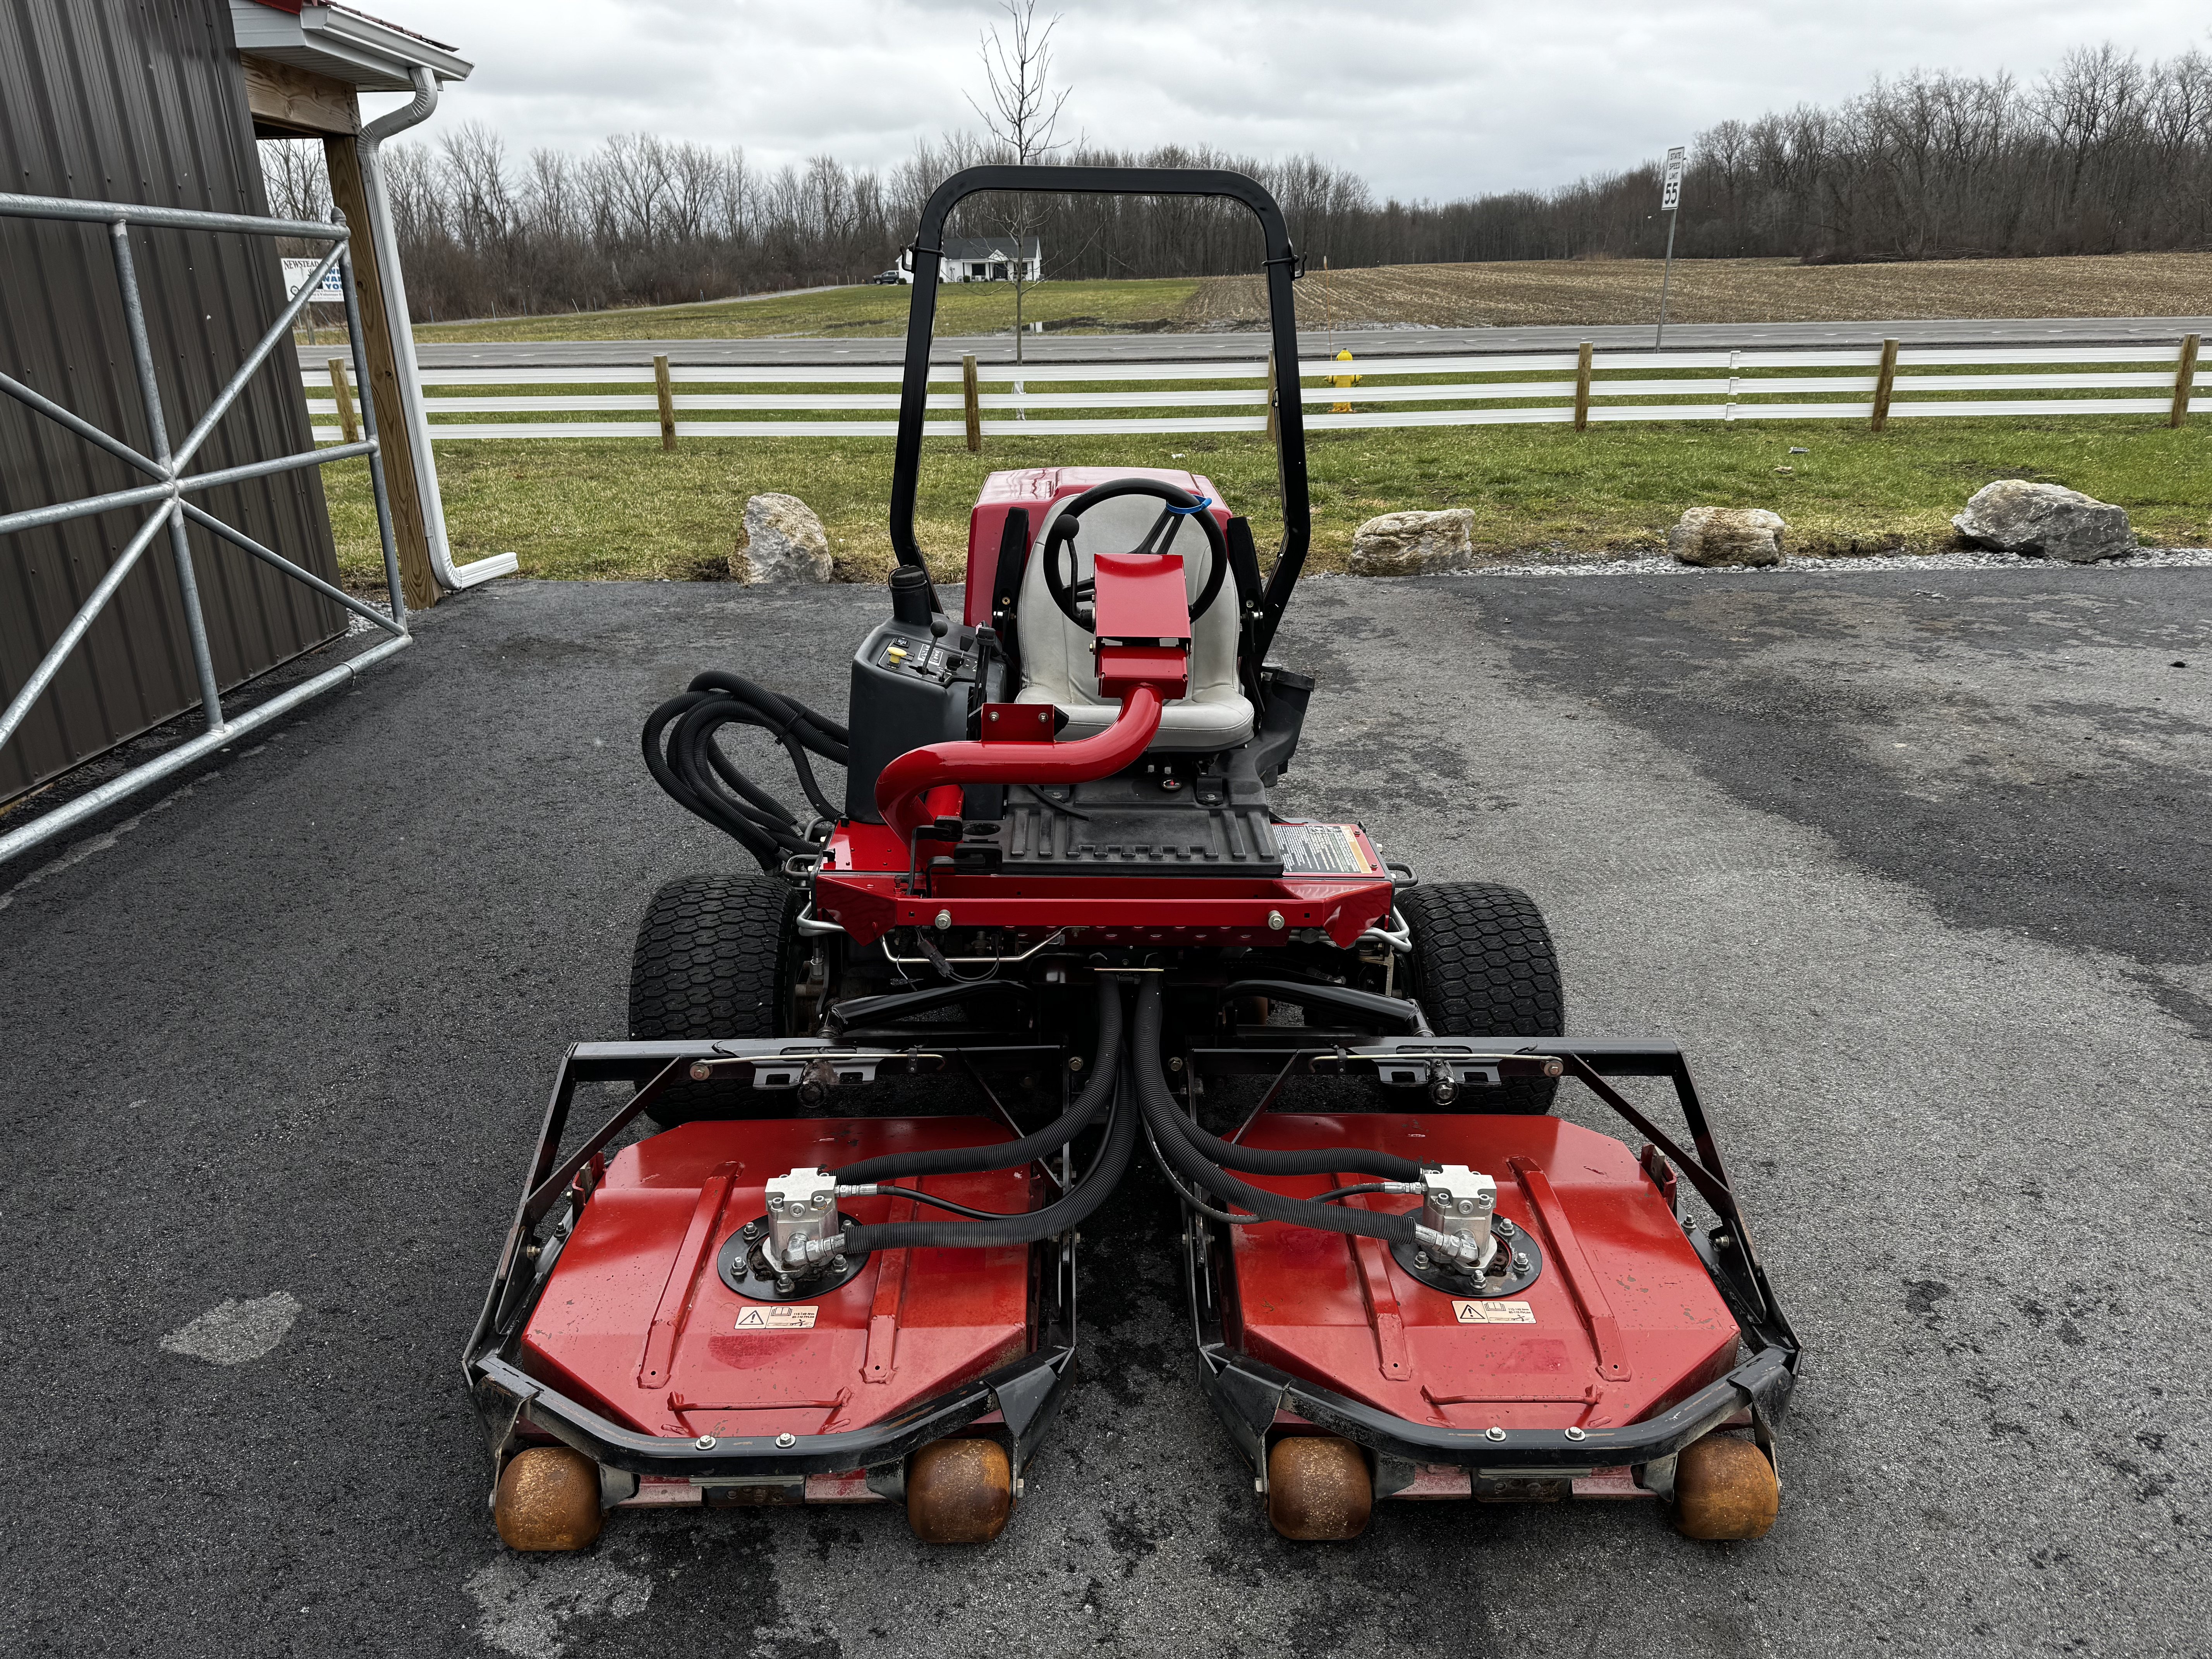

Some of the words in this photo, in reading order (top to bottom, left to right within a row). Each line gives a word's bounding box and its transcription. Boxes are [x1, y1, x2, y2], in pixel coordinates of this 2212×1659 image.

[1670, 152, 1681, 160] STATE
[1669, 162, 1680, 170] SPEED
[1665, 182, 1678, 205] 55
[283, 260, 319, 270] NEWSTEAD
